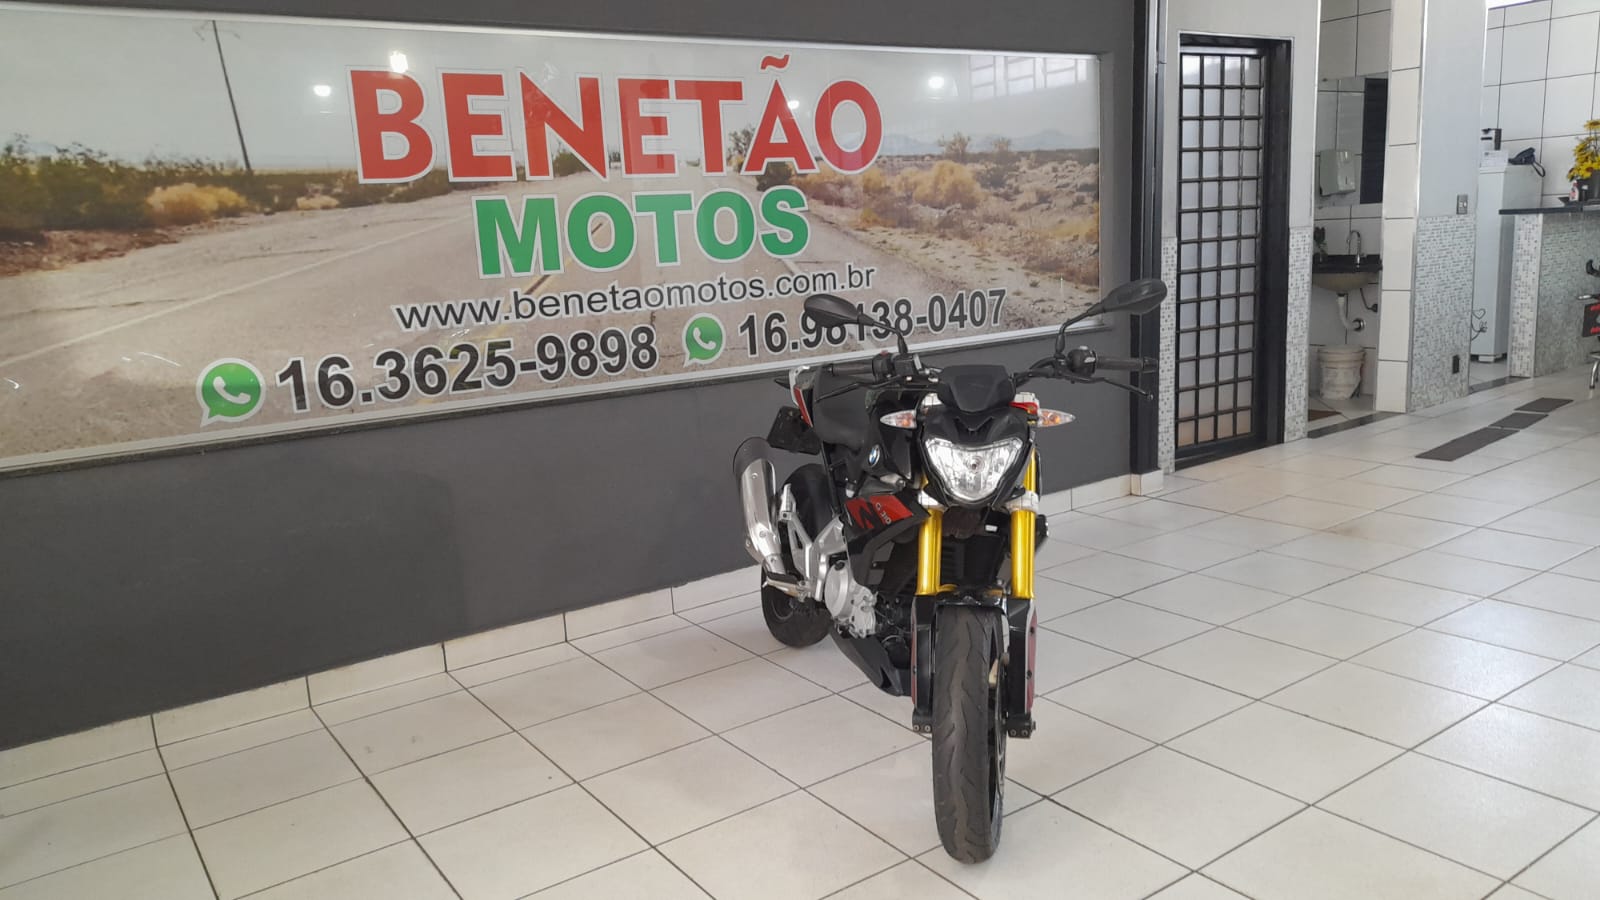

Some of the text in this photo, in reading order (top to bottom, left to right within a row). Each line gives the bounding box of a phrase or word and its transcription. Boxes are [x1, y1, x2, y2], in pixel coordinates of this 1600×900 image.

[349, 54, 882, 181] BENETÃO
[475, 188, 809, 275] MOTOS
[396, 265, 875, 330] www.benetaomotos.com.br
[277, 325, 657, 411] 16.3625-9898
